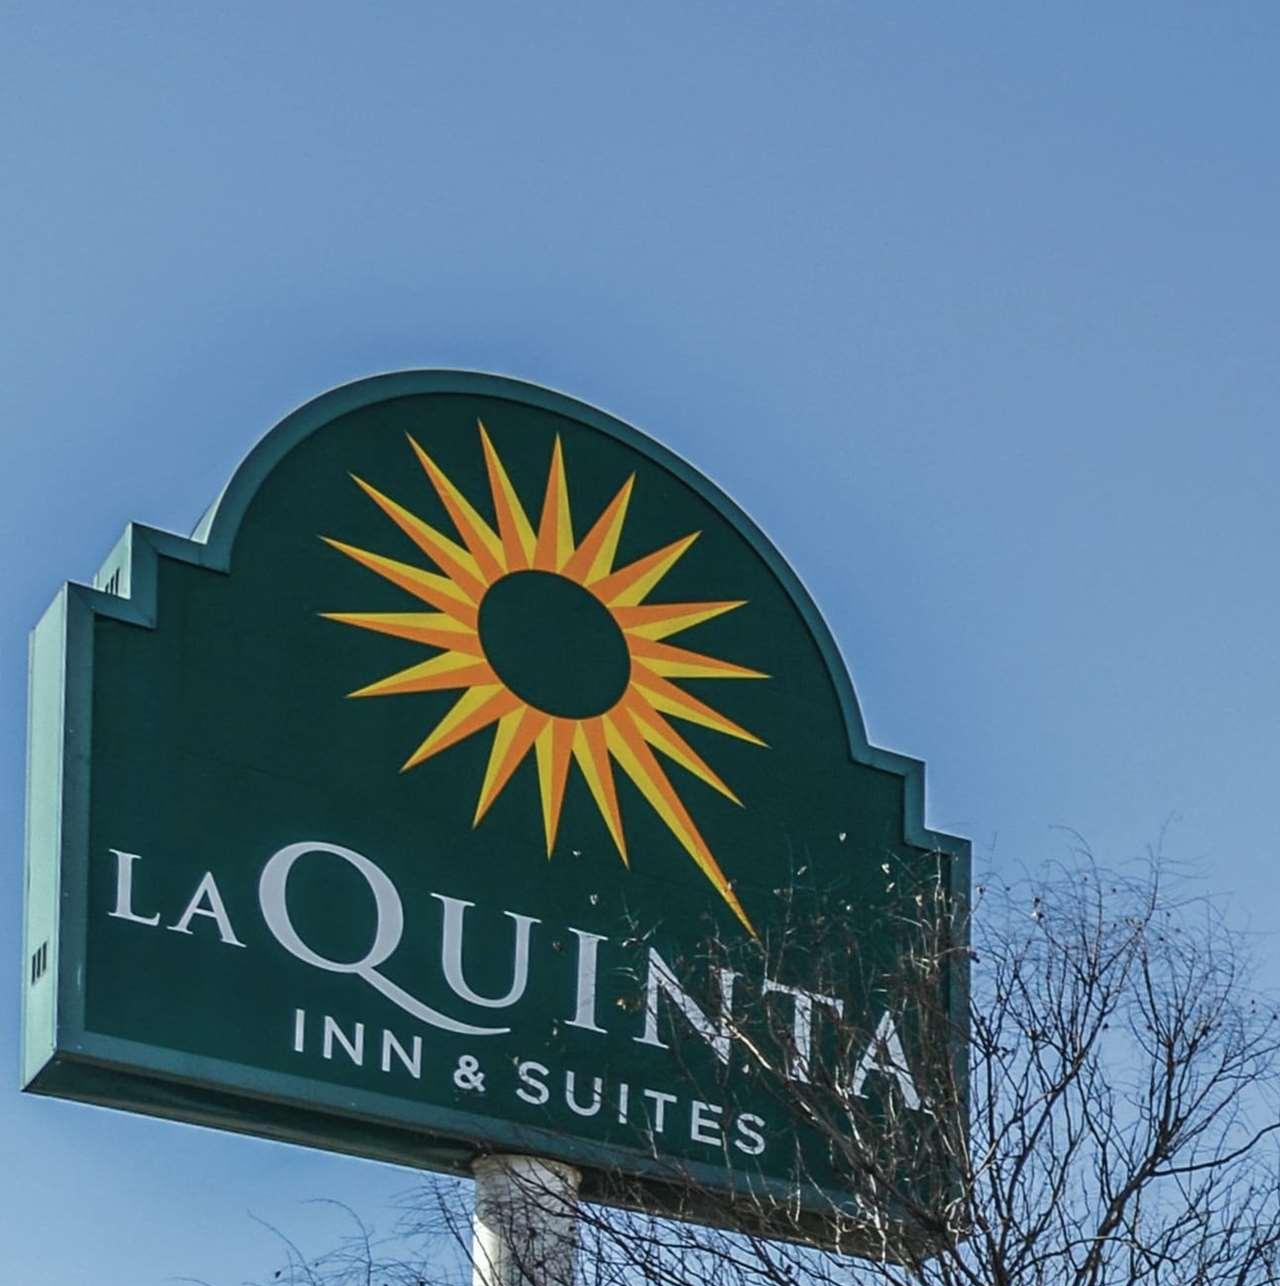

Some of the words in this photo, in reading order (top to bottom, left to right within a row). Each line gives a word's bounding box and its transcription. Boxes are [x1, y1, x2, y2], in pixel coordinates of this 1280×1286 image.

[106, 848, 247, 949] LA
[257, 840, 934, 1116] QUINTA
[293, 1008, 424, 1080] INN
[453, 1054, 485, 1093] &
[515, 1060, 767, 1156] SUITES
